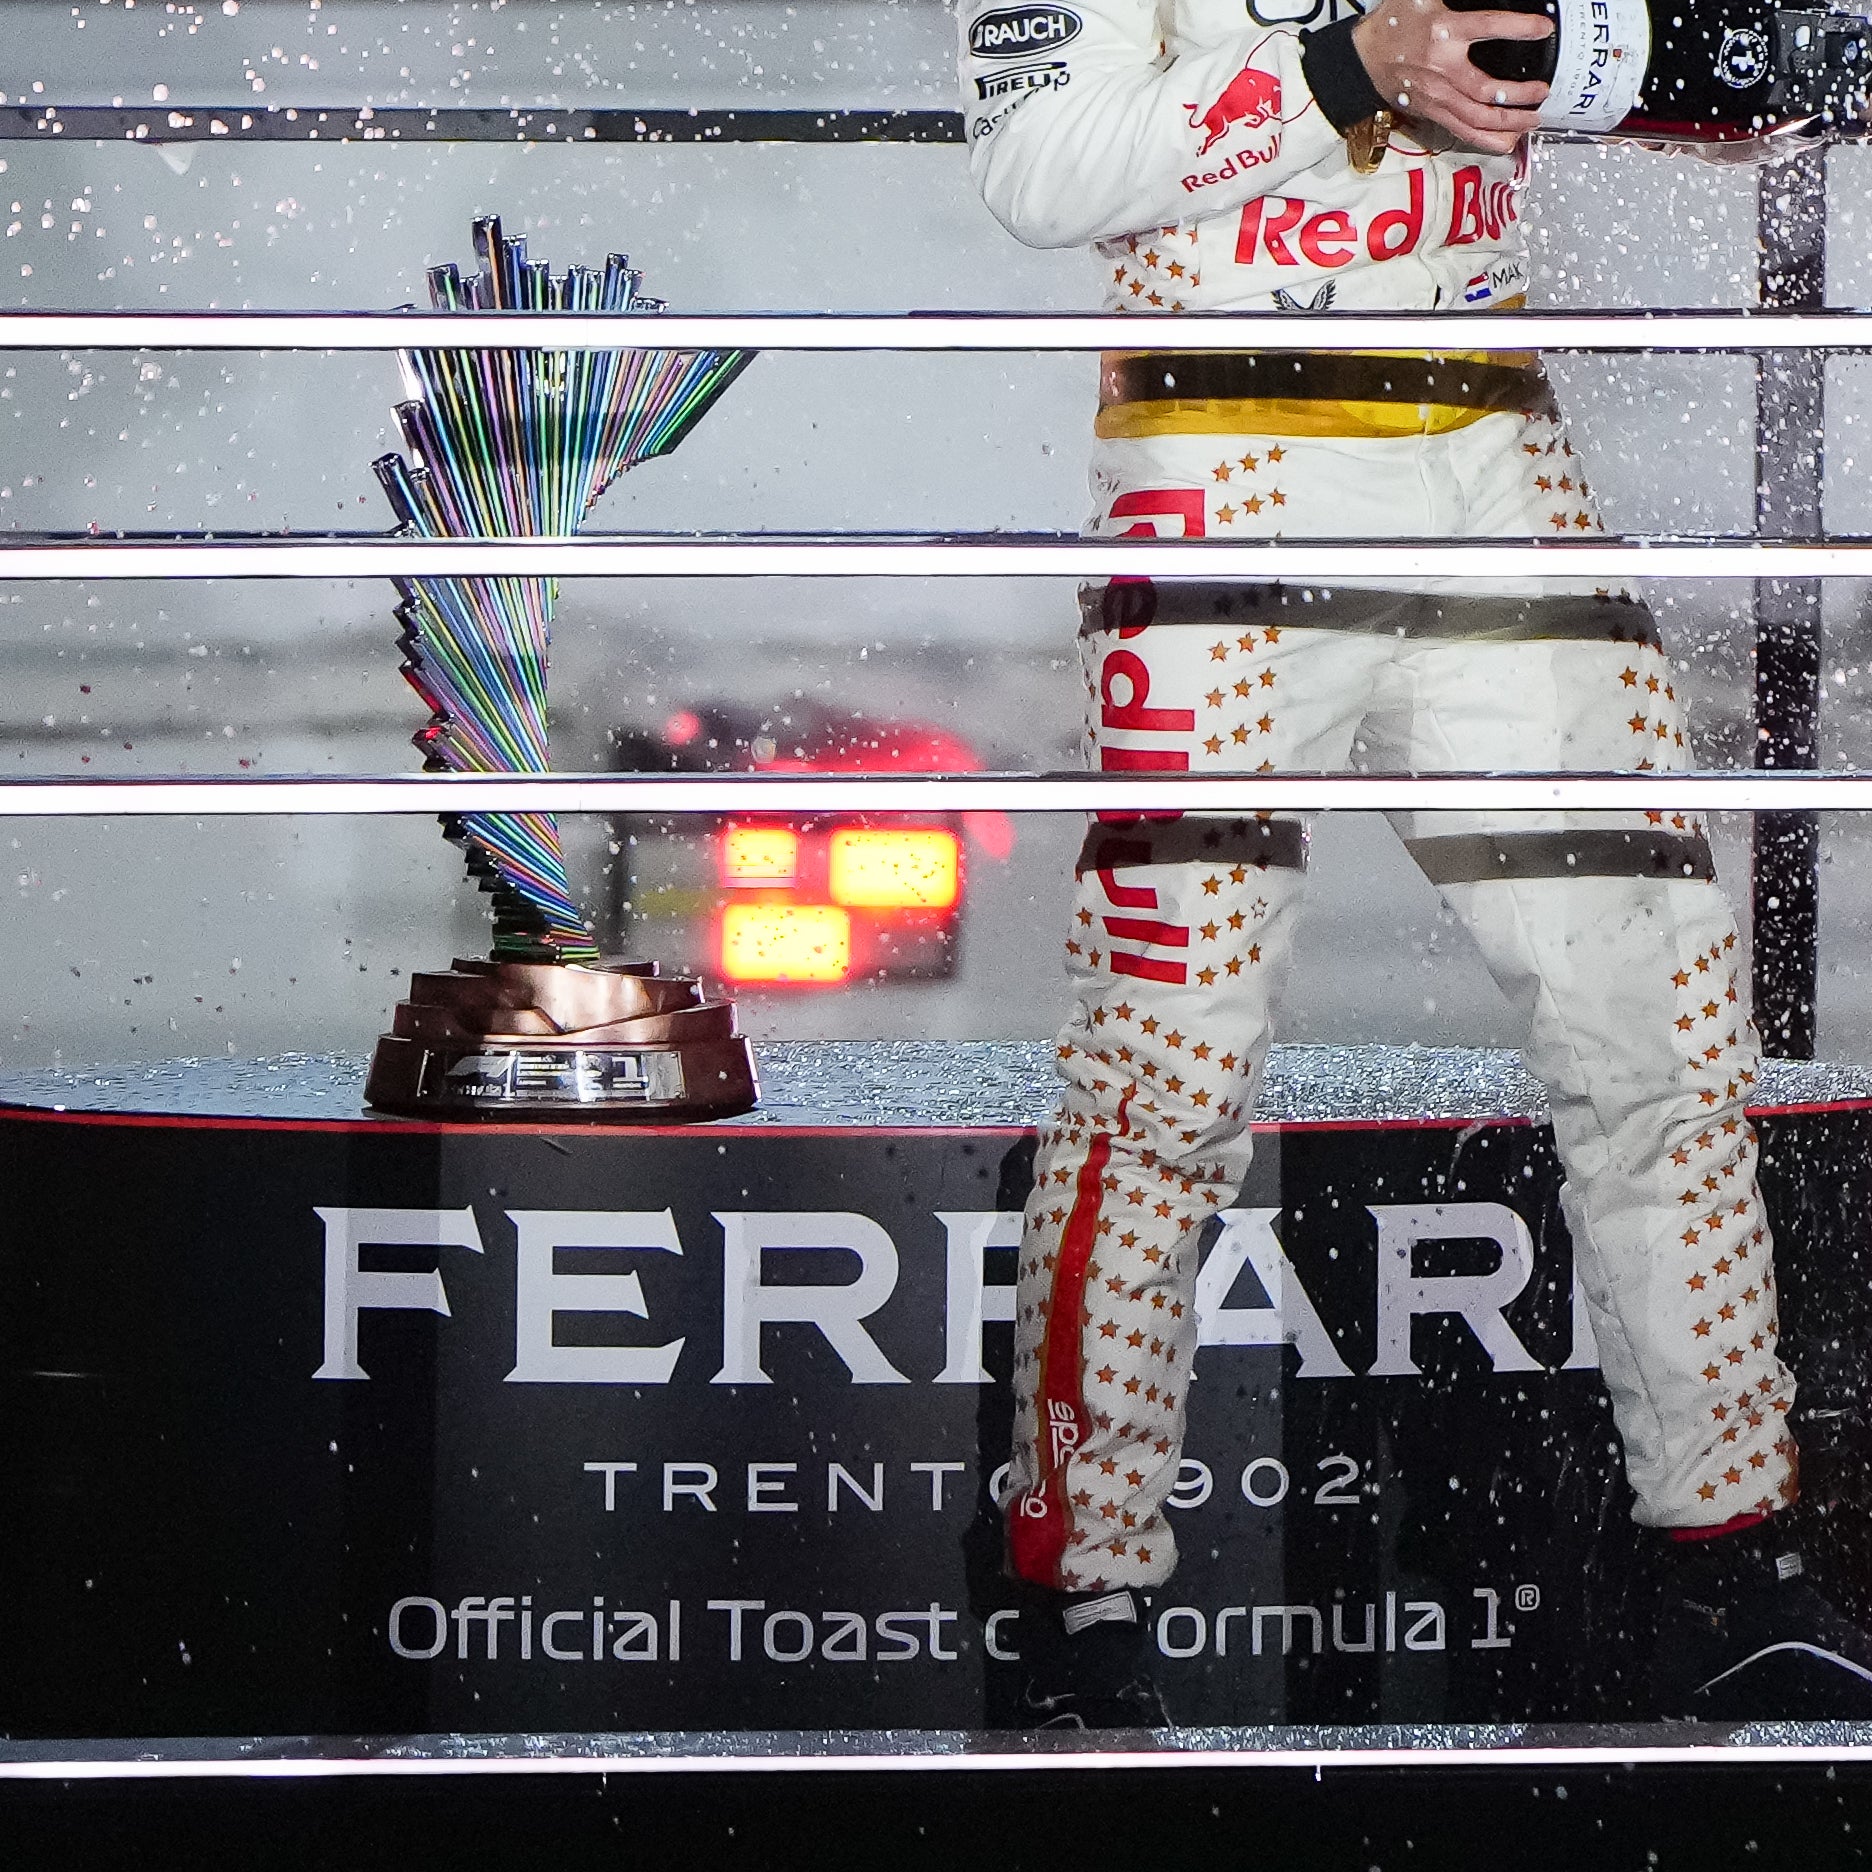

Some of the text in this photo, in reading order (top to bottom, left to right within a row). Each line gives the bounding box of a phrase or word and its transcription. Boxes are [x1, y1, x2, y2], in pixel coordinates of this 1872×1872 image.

[984, 14, 1067, 48] RAUCH
[1179, 156, 1239, 194] Red
[1234, 168, 1423, 268] Red
[1167, 1457, 1361, 1509] 902
[389, 1595, 680, 1662] Official
[708, 1599, 957, 1662] Toast
[1144, 1590, 1446, 1659] ormula
